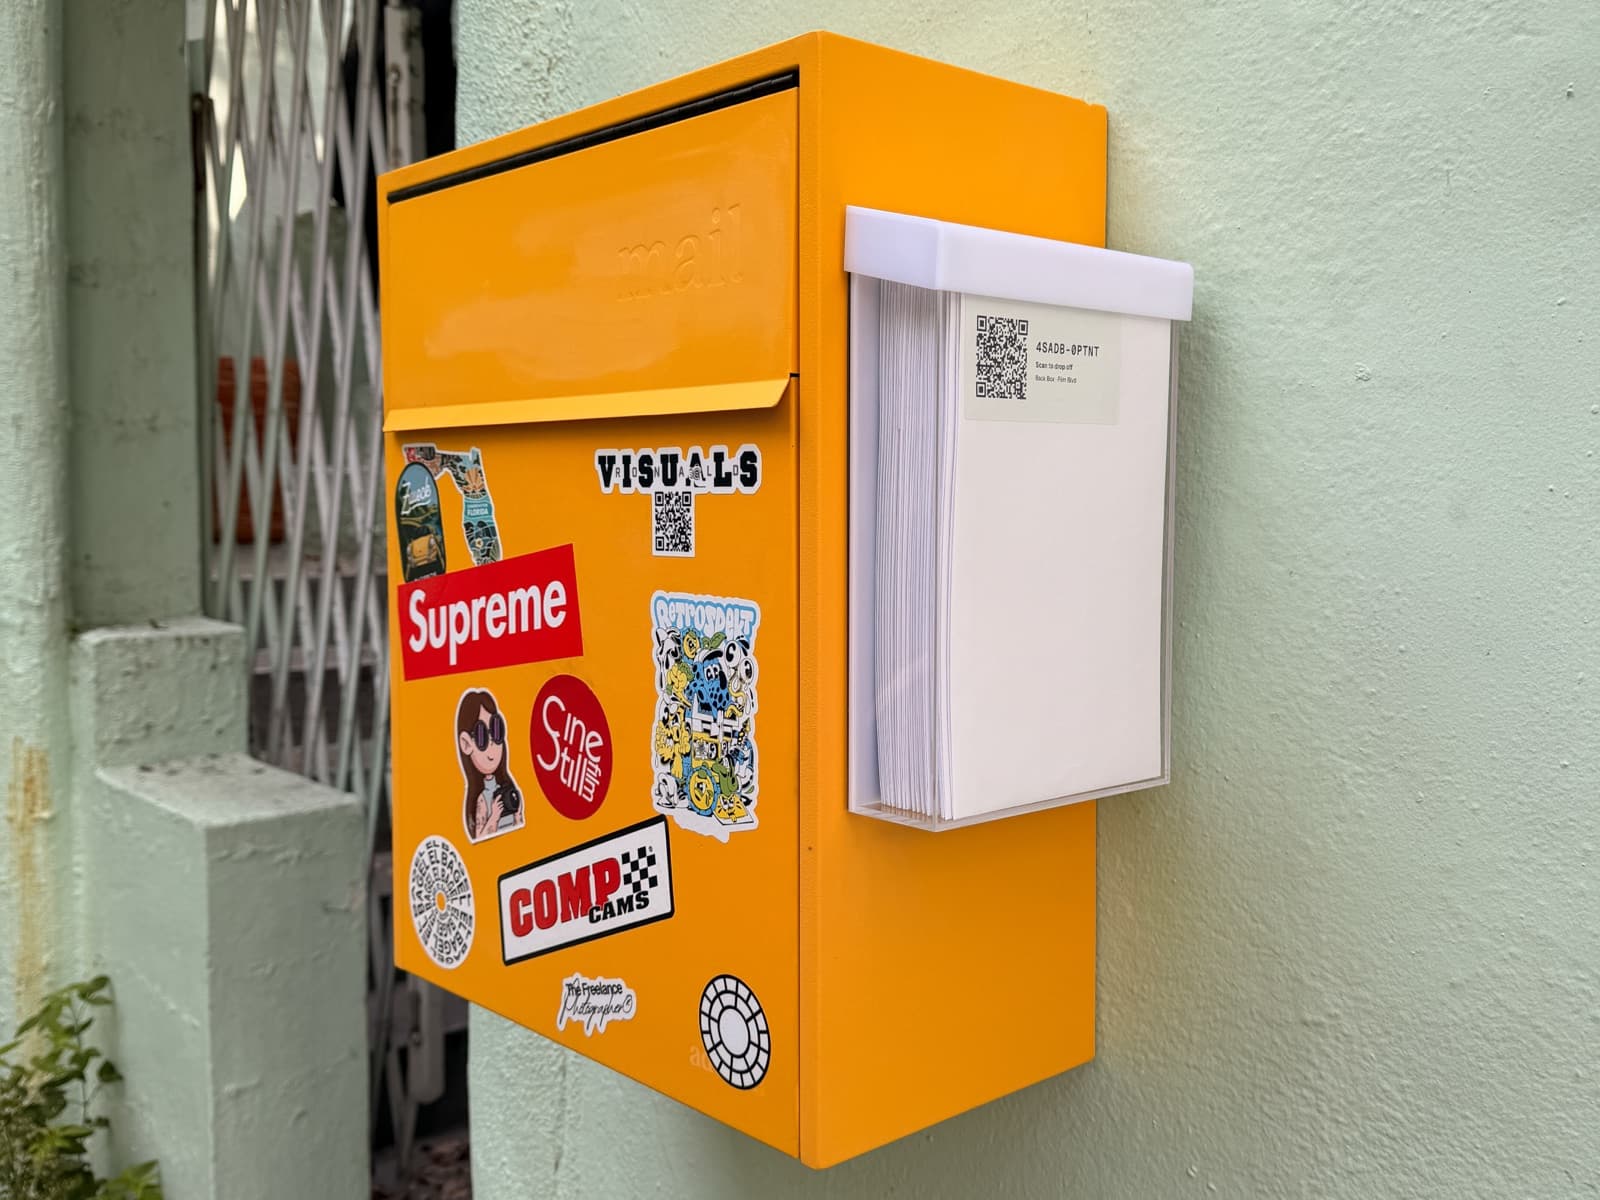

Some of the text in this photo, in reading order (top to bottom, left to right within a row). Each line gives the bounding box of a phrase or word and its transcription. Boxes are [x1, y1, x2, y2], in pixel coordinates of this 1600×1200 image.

[616, 203, 743, 302] mail
[1035, 341, 1100, 357] 4SADB-0PTNT
[598, 451, 758, 488] VISUALS
[408, 580, 567, 666] Supreme
[542, 695, 604, 763] Cine
[536, 732, 588, 797] Still
[582, 759, 602, 802] film
[509, 857, 621, 938] COMP
[589, 890, 650, 924] CAMS
[565, 981, 623, 997] The Freelance
